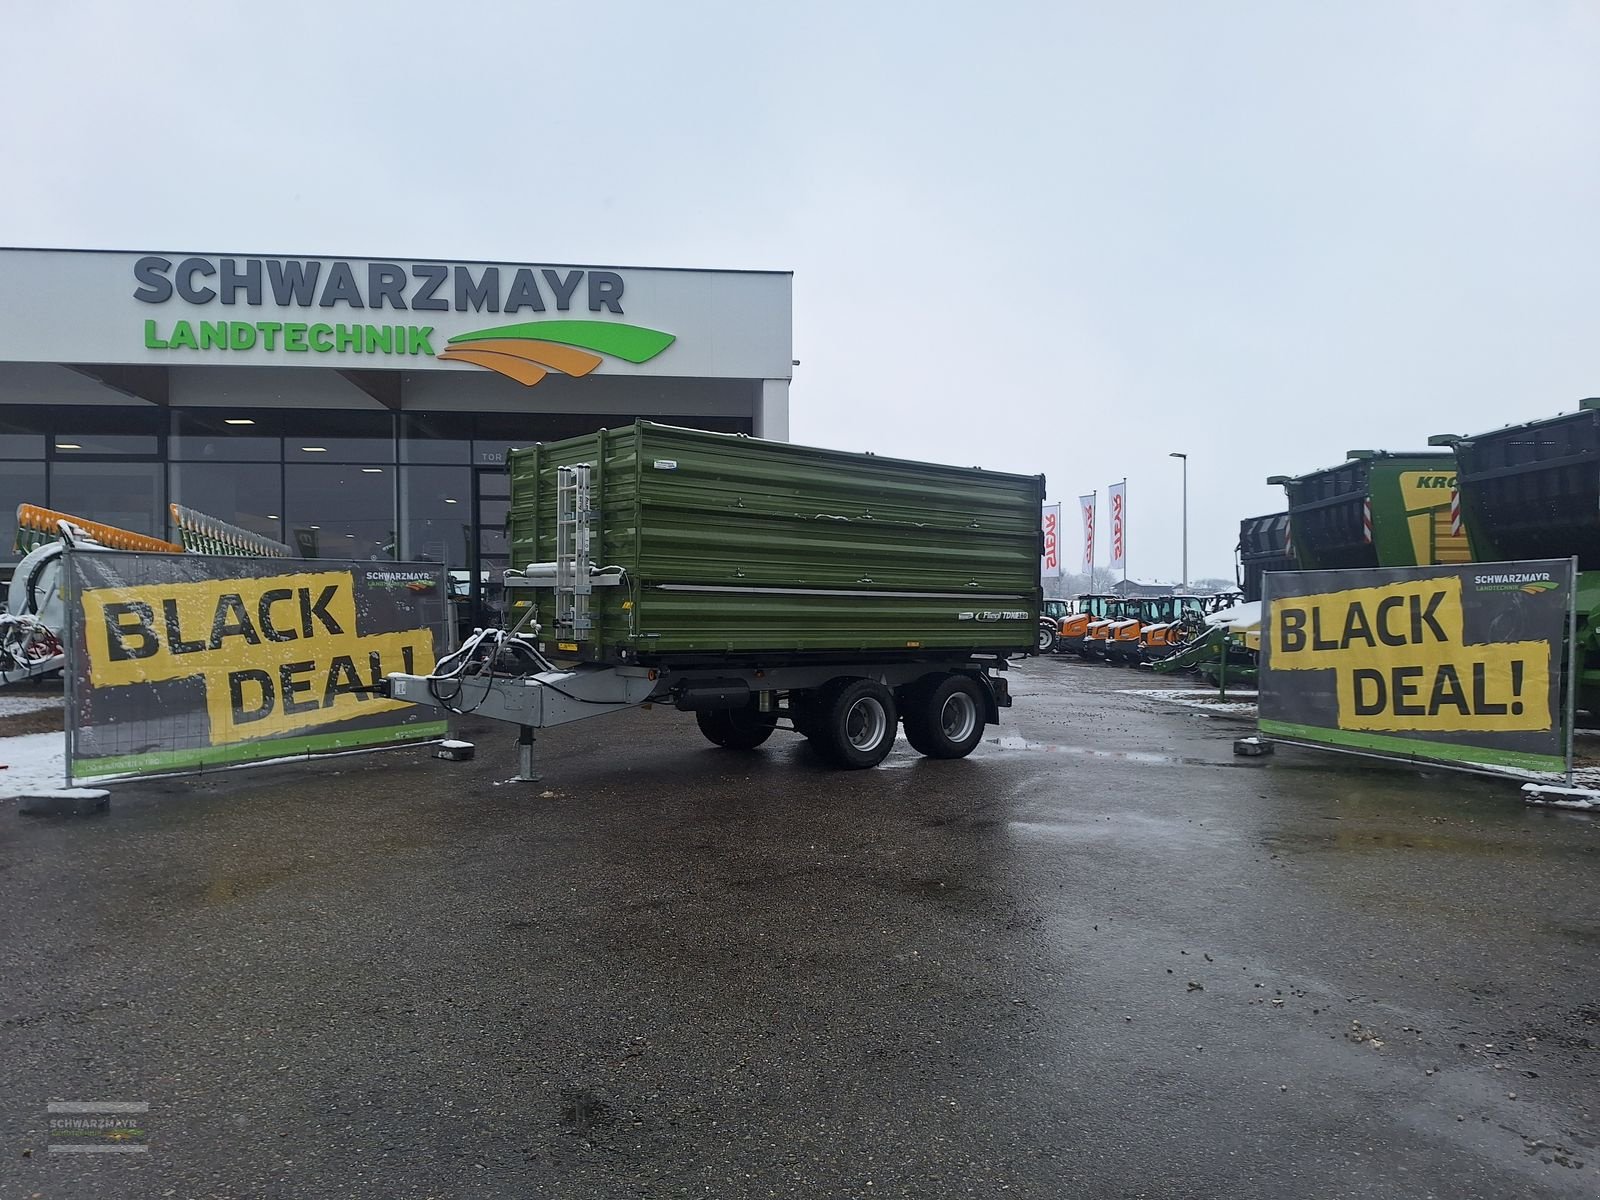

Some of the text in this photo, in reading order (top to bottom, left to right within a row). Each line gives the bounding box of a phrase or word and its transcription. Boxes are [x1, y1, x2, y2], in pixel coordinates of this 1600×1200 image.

[133, 256, 624, 314] SCHWARZMAYR
[144, 319, 435, 356] LANDTECHNIK
[482, 453, 502, 461] TOR
[366, 571, 430, 581] SCHWARZMAYR
[1474, 572, 1550, 584] SCHWARZMAYR
[1475, 584, 1519, 592] LANDTECHNIK
[103, 585, 344, 662] BLACK
[1280, 591, 1448, 653] BLACK
[1353, 660, 1523, 716] DEAL!
